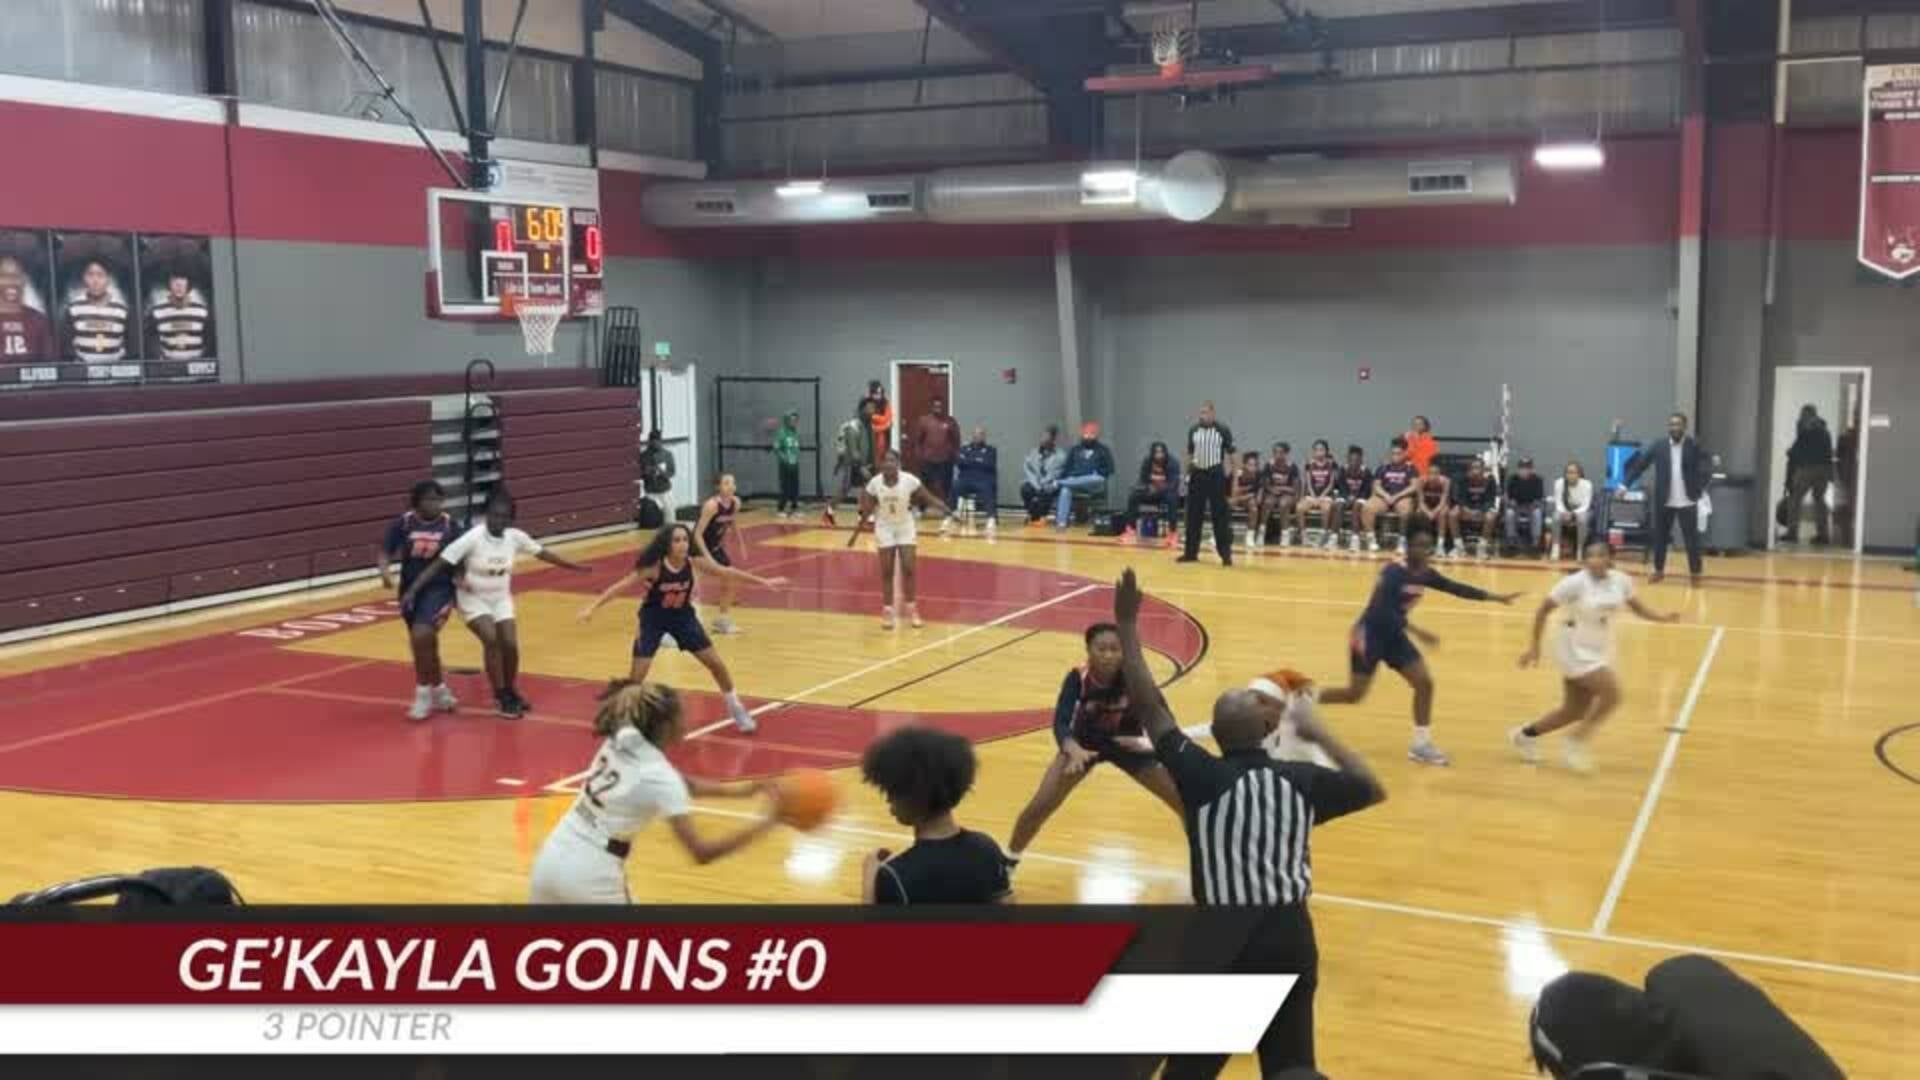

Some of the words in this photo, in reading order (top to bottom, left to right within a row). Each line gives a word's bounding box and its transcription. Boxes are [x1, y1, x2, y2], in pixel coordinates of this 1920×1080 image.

[585, 226, 602, 260] 0
[543, 251, 551, 270] 1
[584, 755, 621, 810] 22
